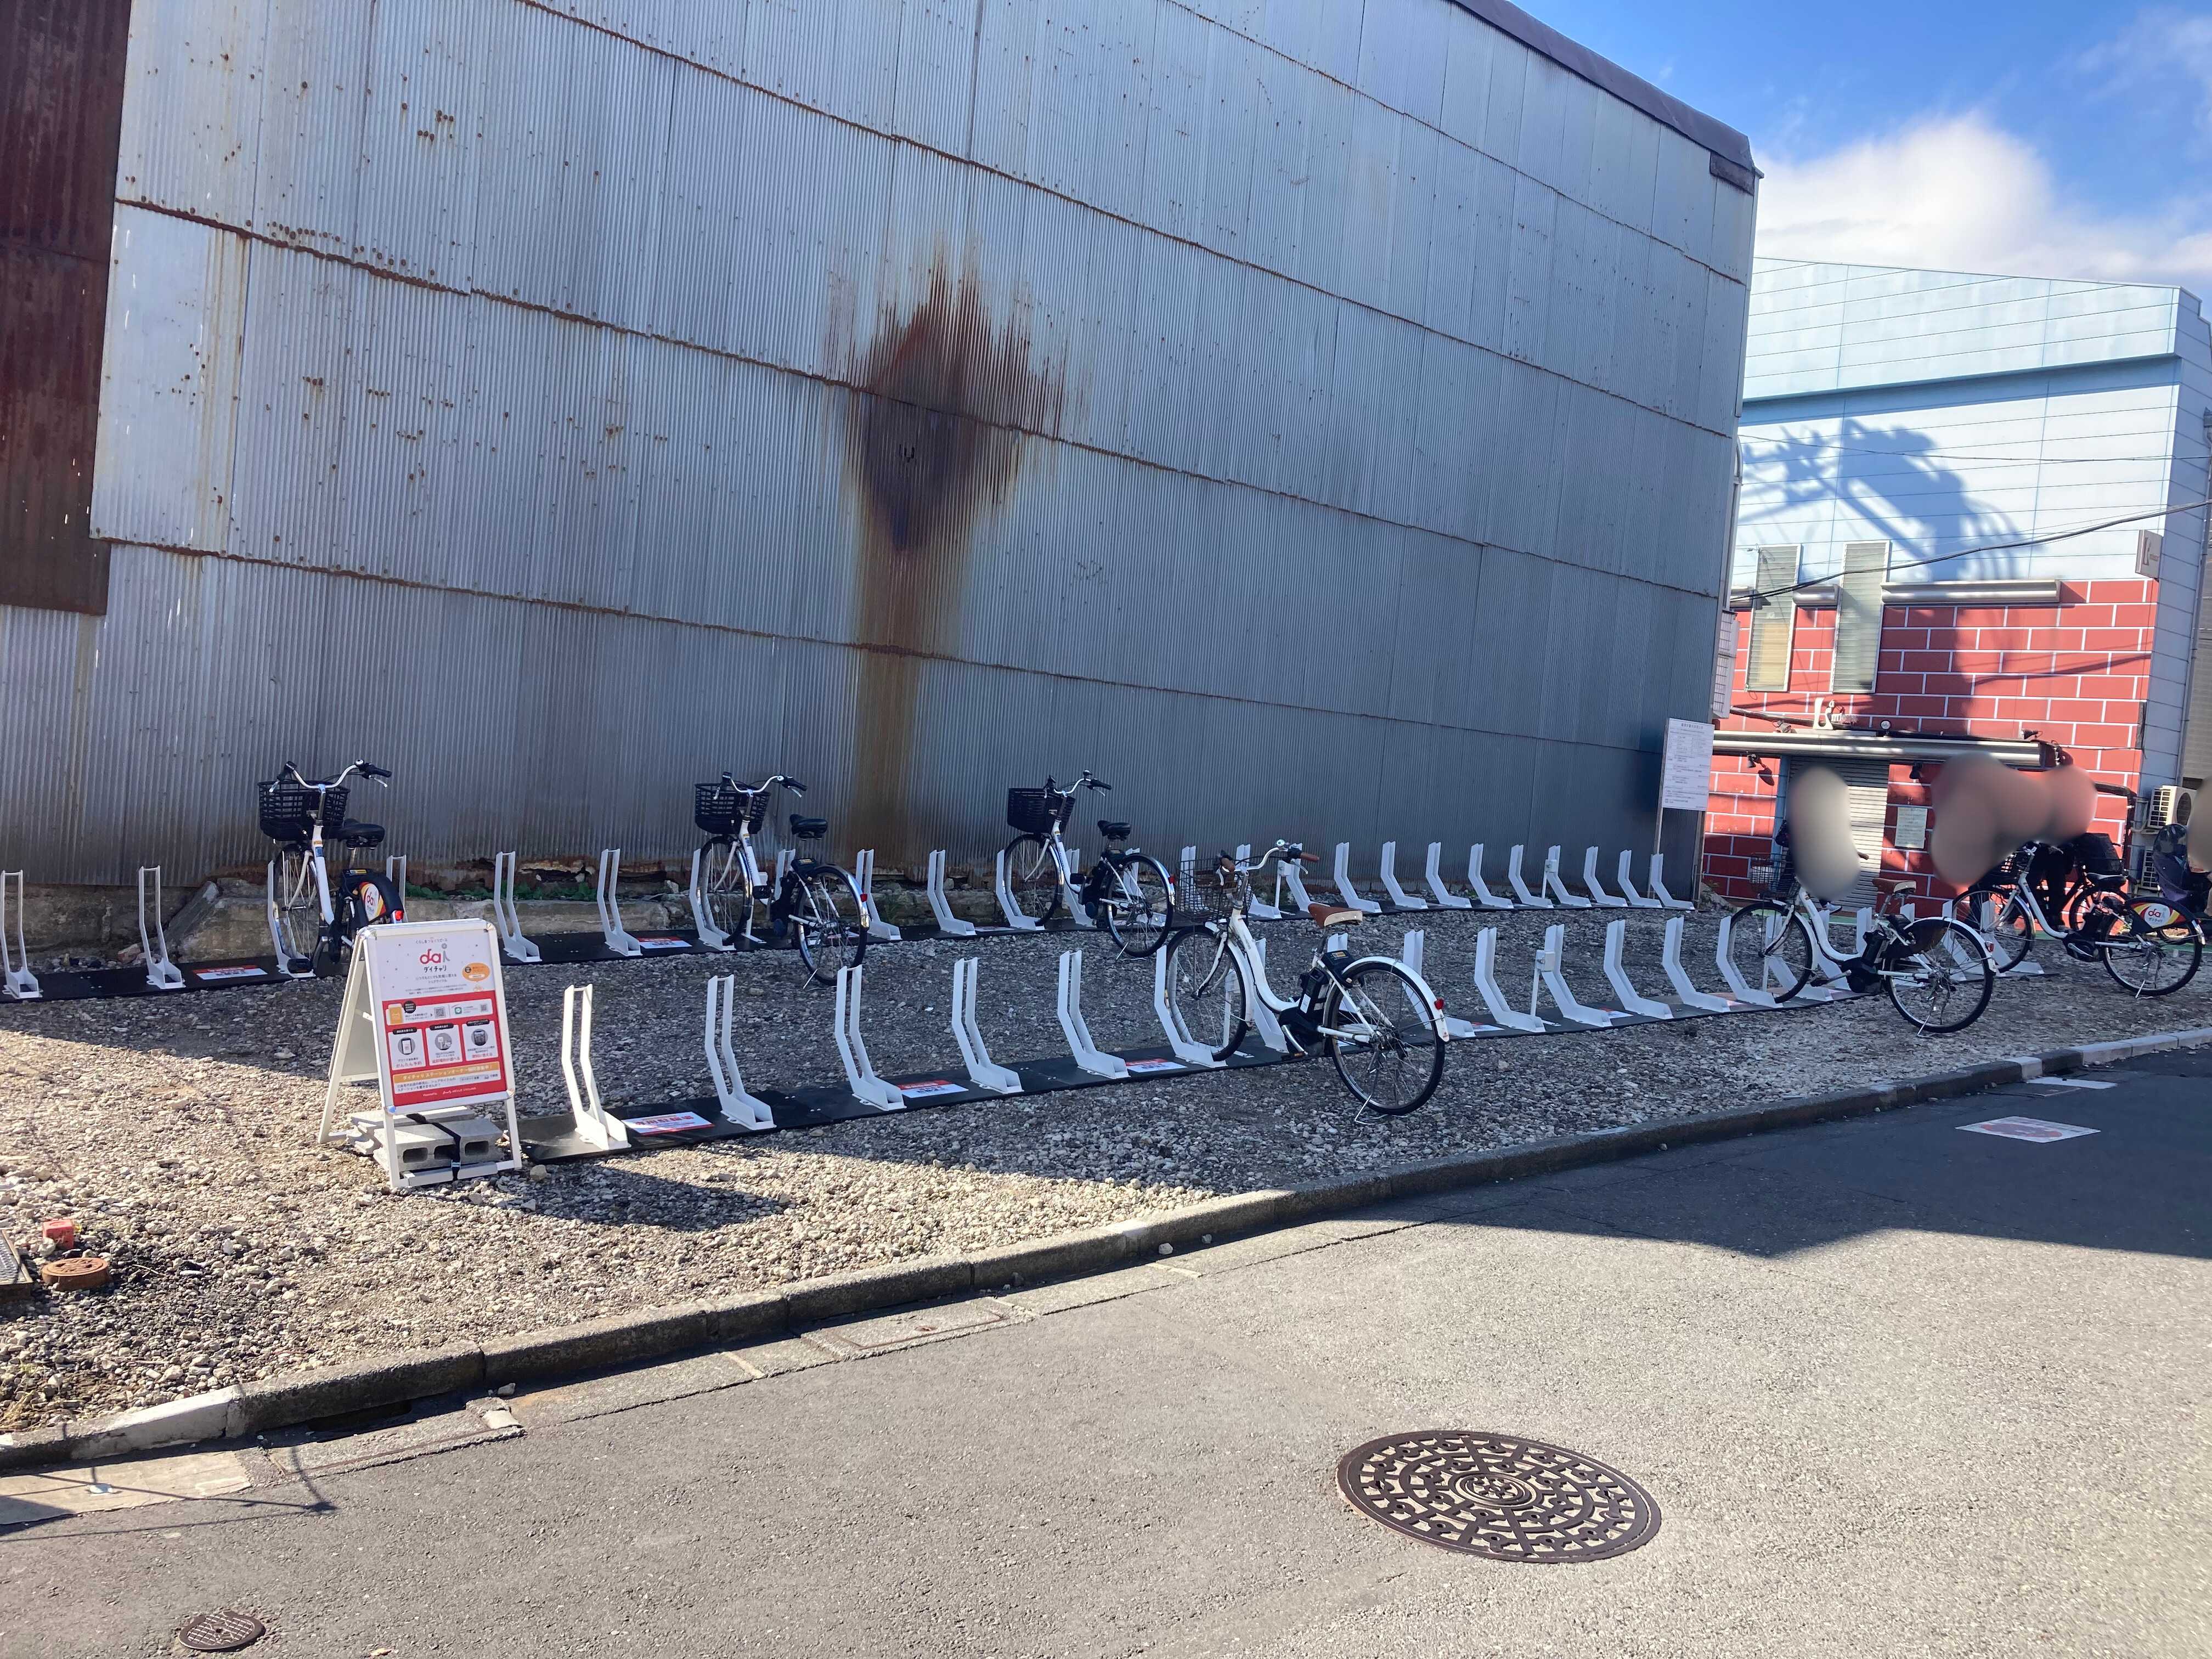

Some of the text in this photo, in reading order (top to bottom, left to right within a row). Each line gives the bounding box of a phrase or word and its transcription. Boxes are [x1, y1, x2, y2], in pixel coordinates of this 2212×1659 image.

[420, 943, 450, 964] dai
[424, 965, 447, 973] ダイチャリ
